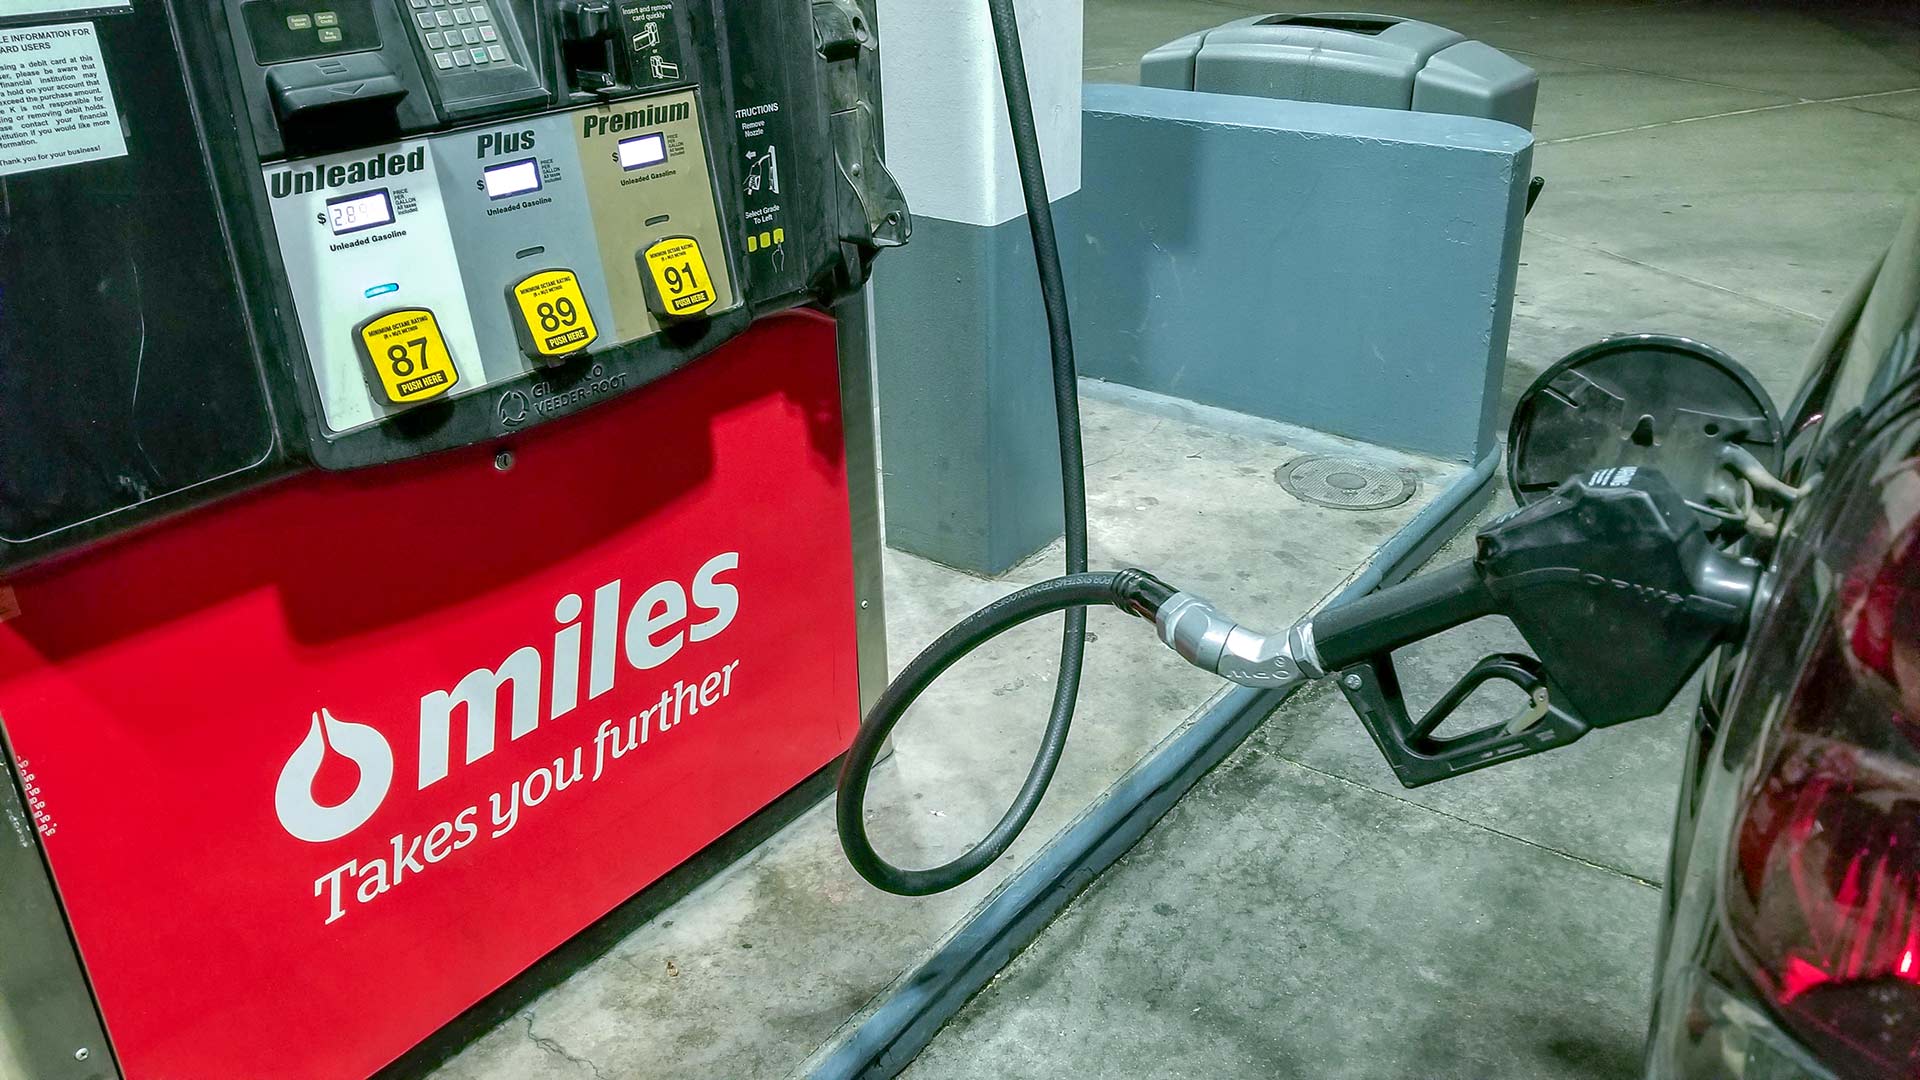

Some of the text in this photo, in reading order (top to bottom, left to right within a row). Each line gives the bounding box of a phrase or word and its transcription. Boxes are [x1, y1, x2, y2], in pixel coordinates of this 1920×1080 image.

[11, 29, 70, 42] INFORMATION
[72, 28, 90, 36] FOR
[21, 42, 51, 51] USERS
[28, 60, 48, 68] debit
[50, 57, 67, 65] card
[15, 70, 40, 78] please
[40, 73, 76, 83] institution
[82, 72, 97, 80] may
[7, 87, 24, 96] hold
[39, 85, 55, 94] your
[57, 82, 84, 90] account
[86, 79, 100, 87] that
[40, 92, 73, 101] purchase
[49, 99, 90, 108] responsible
[21, 120, 49, 129] contact
[56, 117, 72, 125] your
[79, 111, 109, 120] financial
[28, 111, 62, 120] removing
[65, 107, 83, 115] debit
[583, 101, 690, 138] Premium
[38, 128, 53, 136] you
[741, 120, 765, 130] Remove
[744, 128, 764, 138] Nozzle
[67, 145, 101, 155] business!
[477, 130, 535, 159] Plus
[271, 146, 425, 198] Unleaded
[620, 169, 677, 186] Unleaded Gasoline
[476, 179, 485, 191] $
[487, 197, 552, 216] Unleaded Gasoline
[745, 204, 780, 219] Select Grade
[317, 212, 327, 225] $
[753, 213, 773, 225] To Left
[329, 229, 407, 252] Unleaded Gasoline
[664, 262, 697, 294] 91
[674, 292, 707, 308] PUSH HERE
[537, 297, 577, 332] 89
[549, 329, 585, 347] PUSH HERE
[387, 336, 429, 377] 87
[401, 373, 444, 394] PUSH HERE
[533, 372, 627, 416] VEEDER-ROOT
[418, 551, 739, 790] miles
[314, 659, 739, 926] Takes you further
